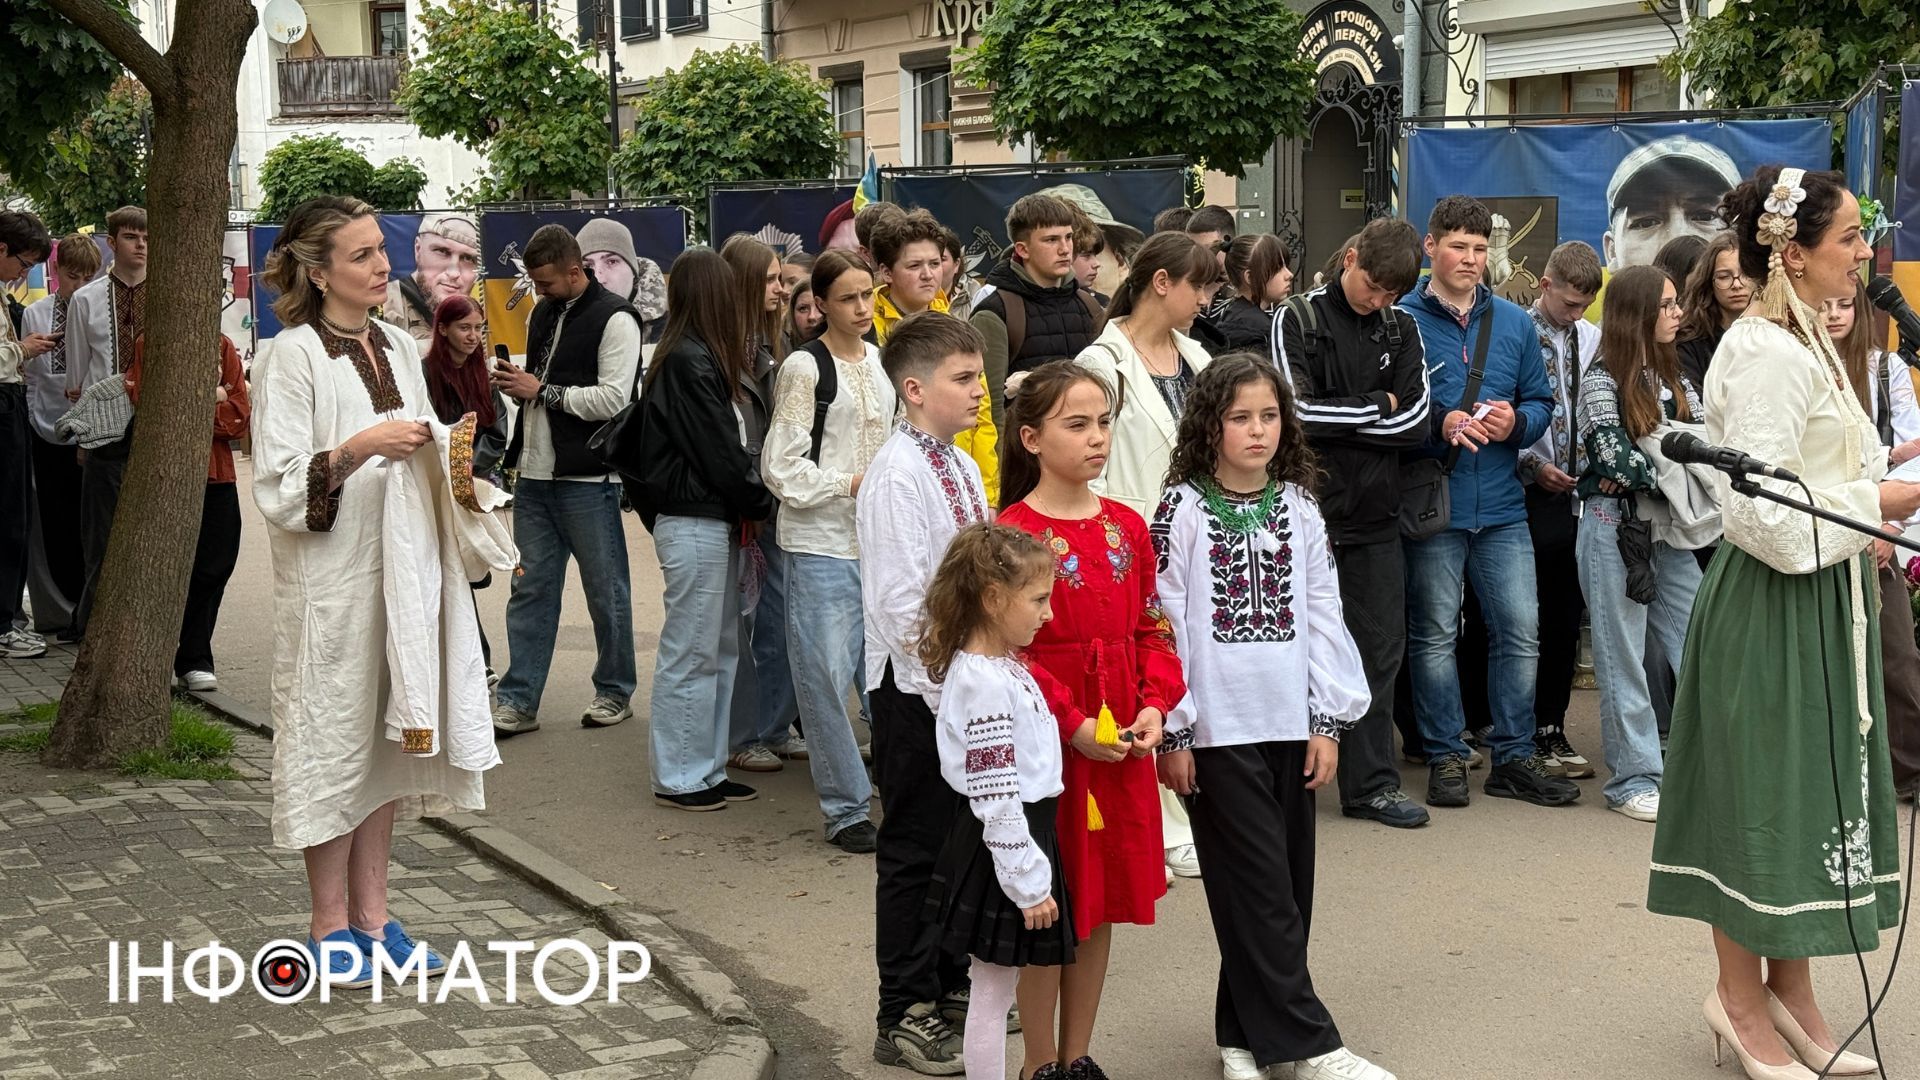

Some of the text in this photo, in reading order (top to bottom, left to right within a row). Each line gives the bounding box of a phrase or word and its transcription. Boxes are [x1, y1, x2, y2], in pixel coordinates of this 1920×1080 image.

[932, 0, 992, 48] Кра
[1334, 10, 1382, 42] ГРОШОВІ
[1306, 35, 1328, 60] ION
[1335, 28, 1384, 73] ПЕРЕКАЗИ
